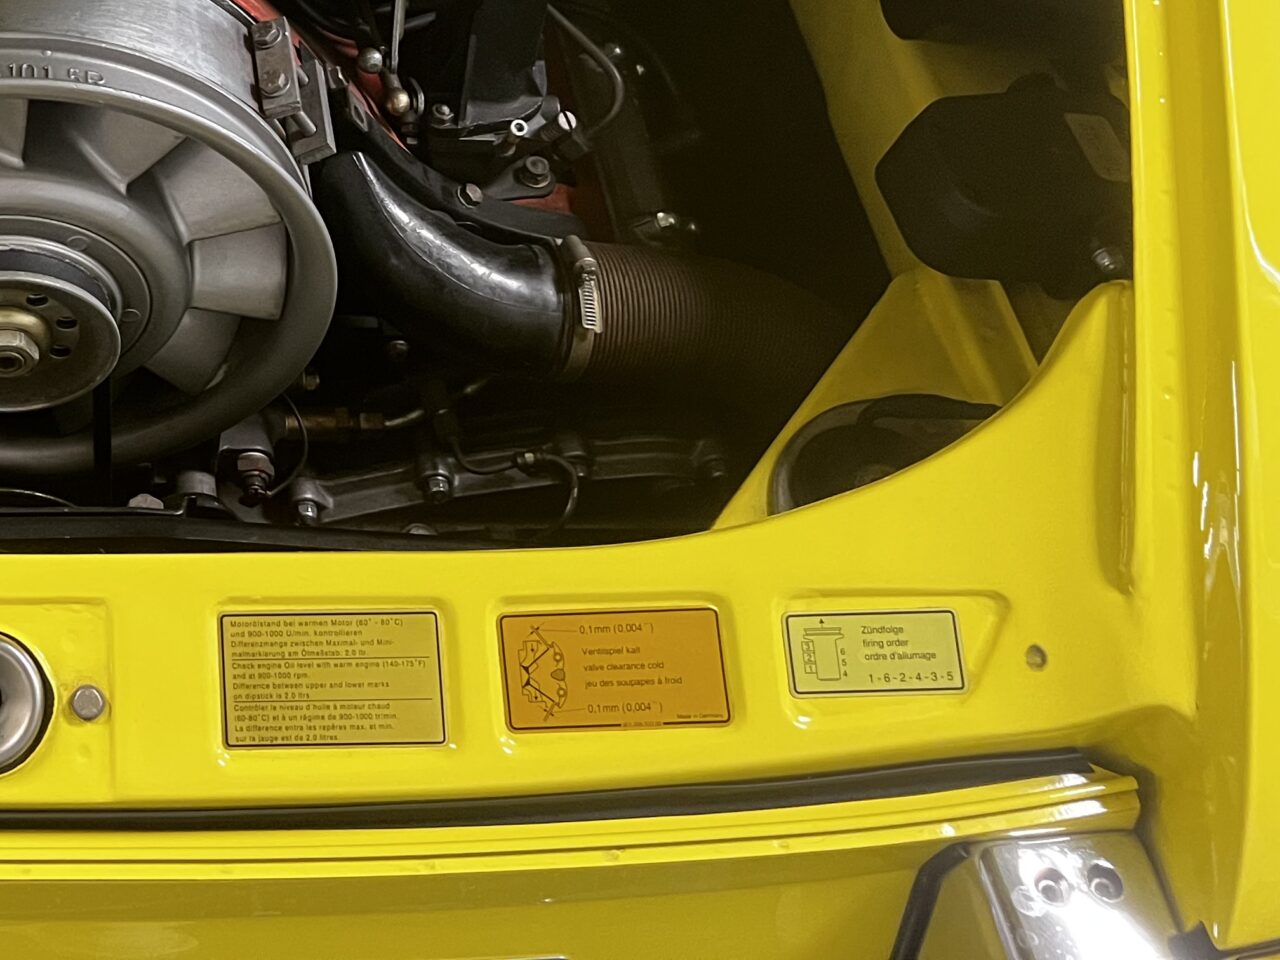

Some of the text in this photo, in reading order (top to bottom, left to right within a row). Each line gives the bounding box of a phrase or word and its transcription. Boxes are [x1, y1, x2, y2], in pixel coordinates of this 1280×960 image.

[861, 625, 904, 636] Zündfolge
[862, 639, 909, 649] firing order
[581, 646, 641, 655] Ventilspiel kalt
[864, 652, 888, 661] ordre
[583, 661, 665, 672] valve clearance cold
[305, 683, 327, 691] upper
[585, 680, 598, 690] jeu
[617, 678, 656, 687] soupapes
[657, 676, 663, 685] à
[665, 676, 683, 685] froid
